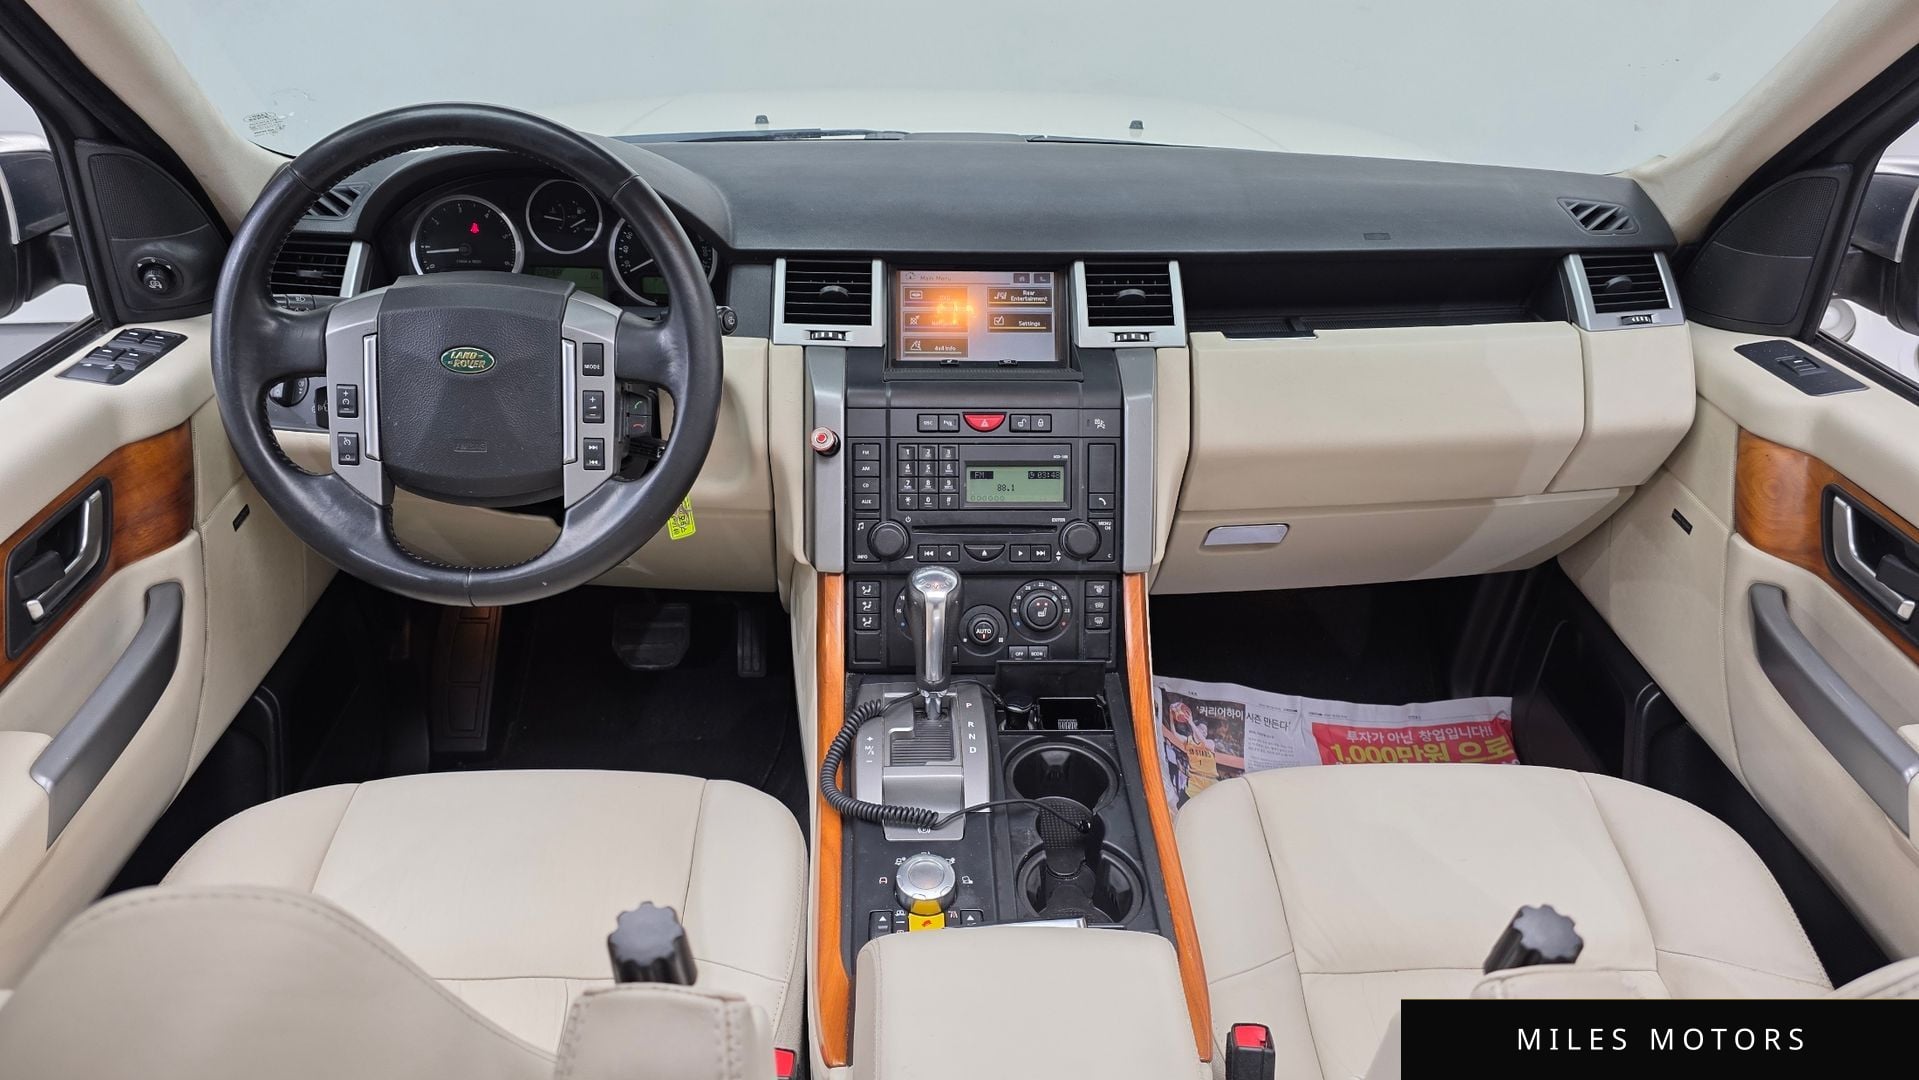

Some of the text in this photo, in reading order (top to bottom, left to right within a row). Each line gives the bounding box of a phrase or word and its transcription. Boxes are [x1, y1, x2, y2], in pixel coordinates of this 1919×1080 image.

[450, 351, 478, 360] LAND
[453, 359, 486, 369] ROVER
[974, 471, 985, 479] FM
[996, 483, 1015, 492] 88.1
[1246, 711, 1262, 725] 시즌
[1346, 730, 1385, 745] 투자가
[1387, 729, 1414, 745] 아닌
[1458, 735, 1514, 763] 으로
